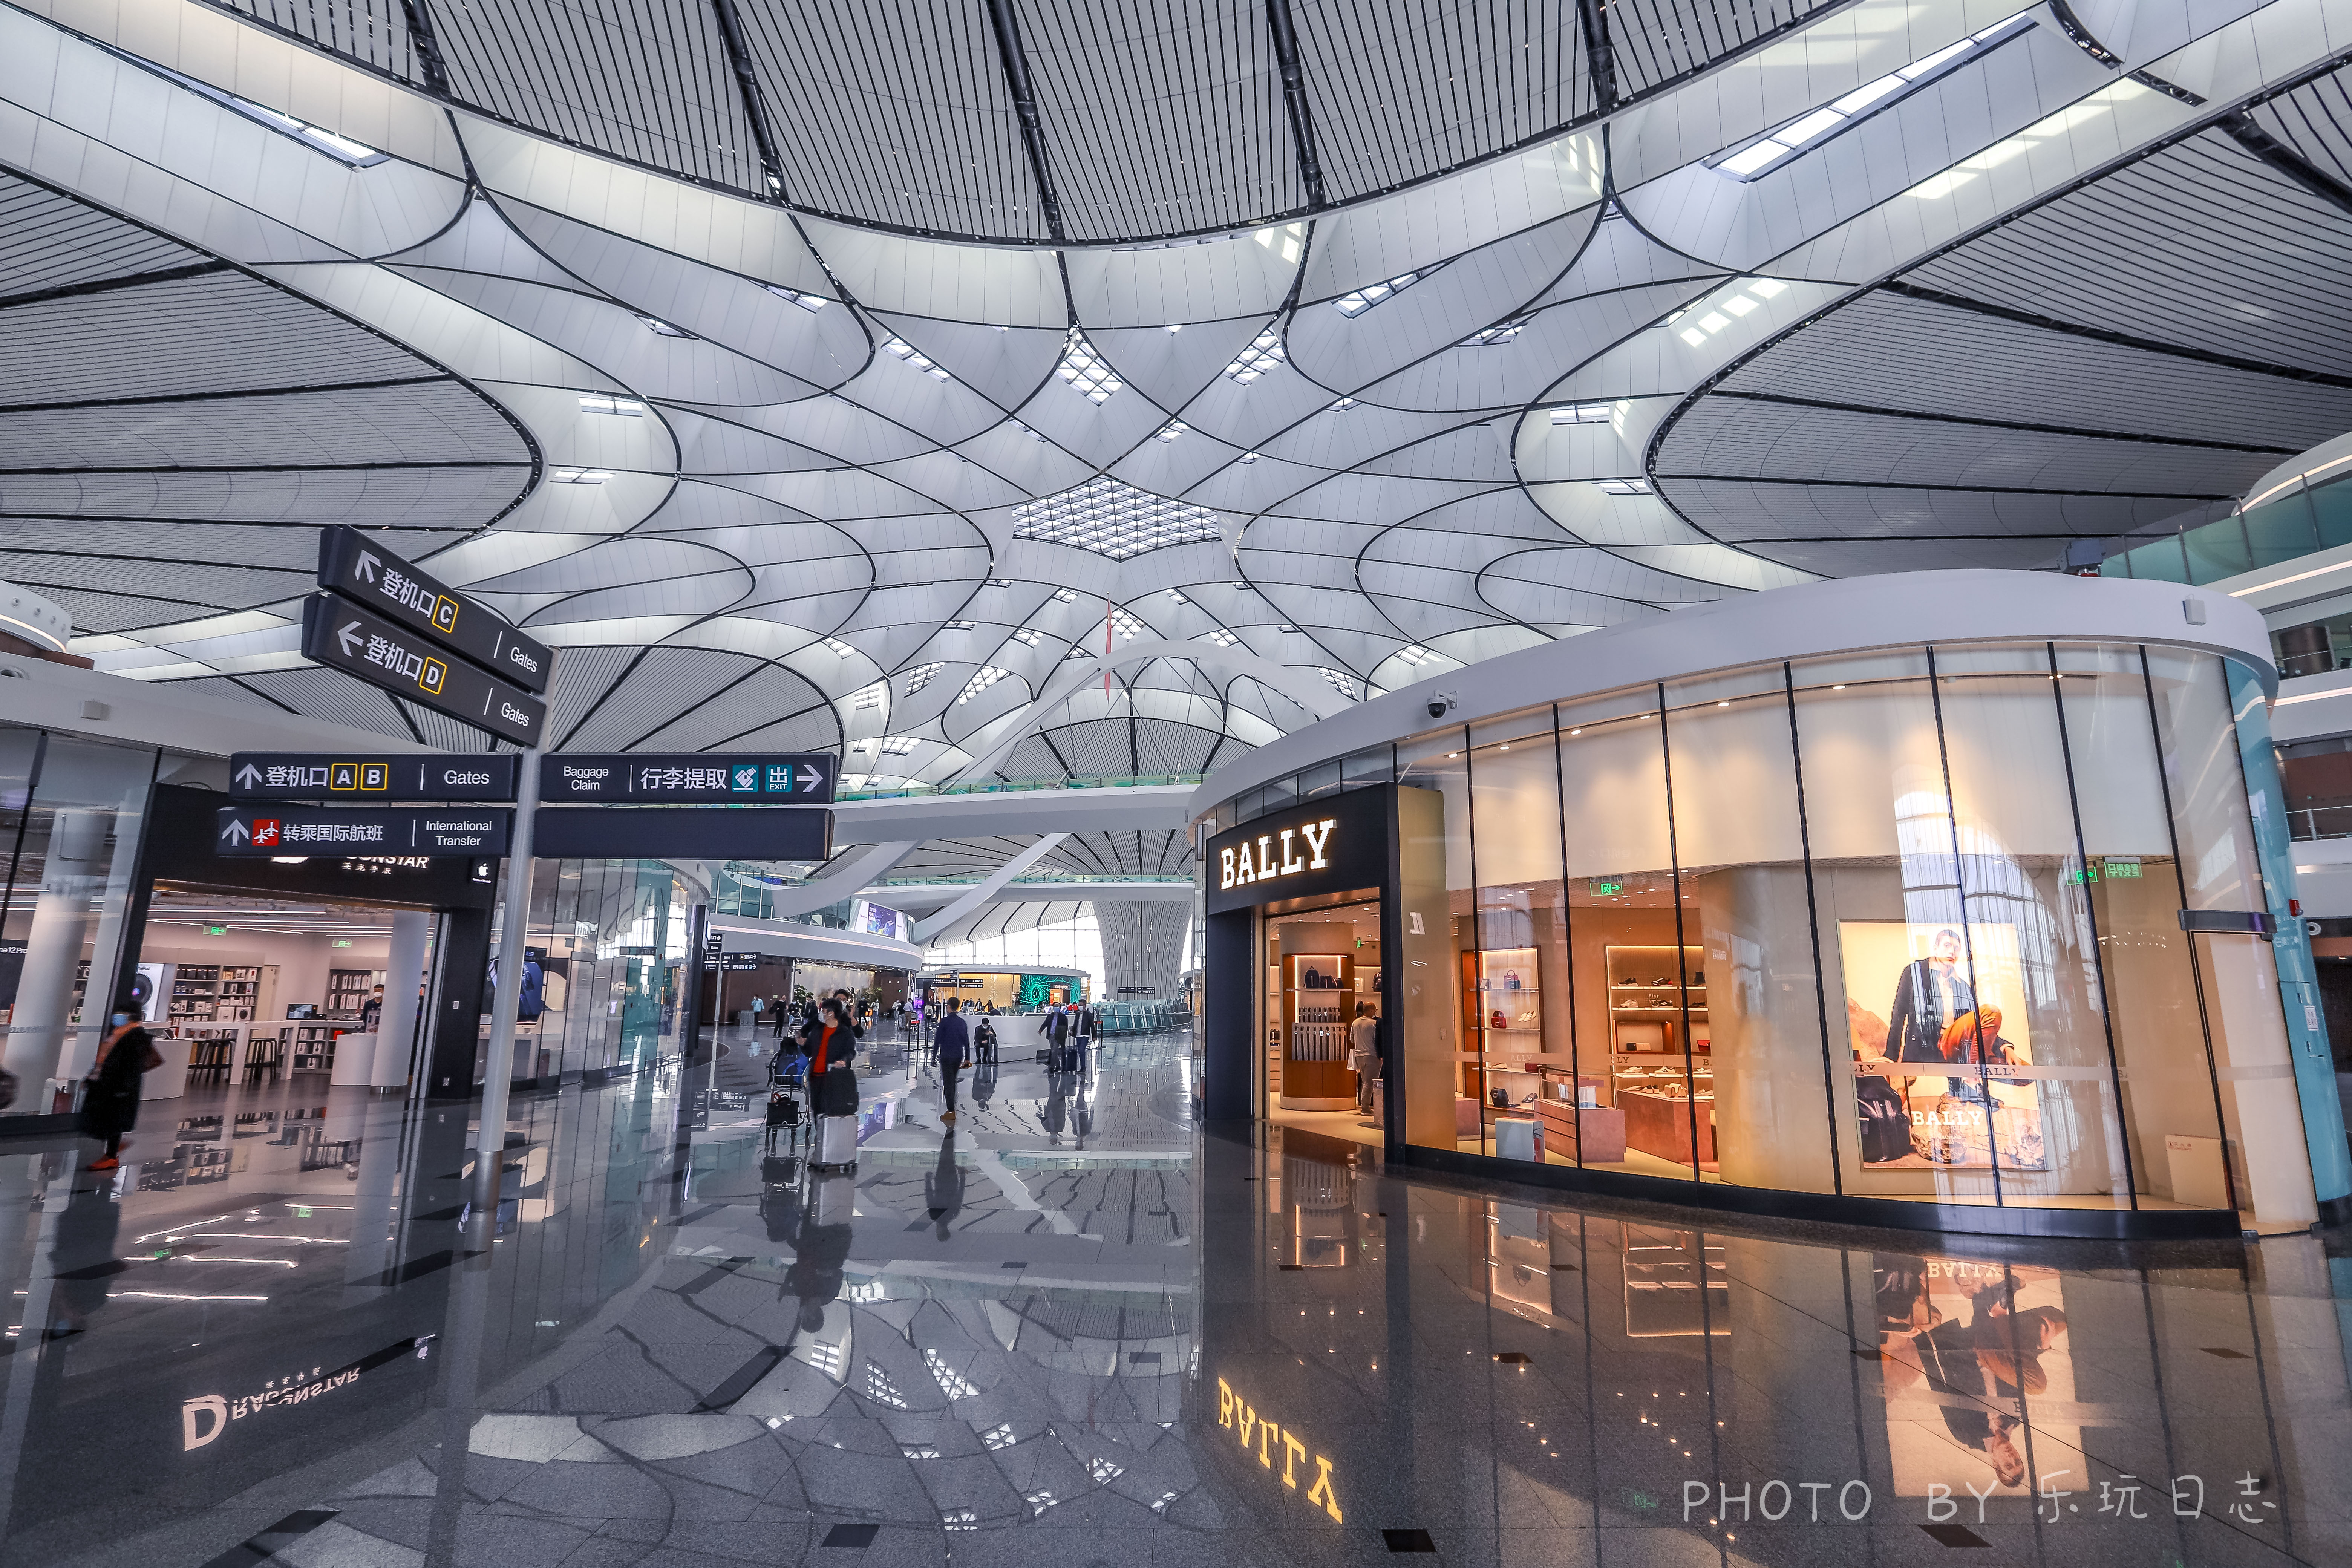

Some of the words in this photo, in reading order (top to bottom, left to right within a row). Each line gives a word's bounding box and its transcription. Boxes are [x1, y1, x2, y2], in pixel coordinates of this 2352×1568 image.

[378, 567, 436, 618] 登机口
[439, 605, 452, 624] C
[363, 634, 423, 681] 登机口
[426, 665, 439, 684] D
[510, 646, 538, 673] Gates
[501, 701, 530, 727] Gates
[265, 765, 329, 787] 登机口
[336, 769, 351, 784] A
[367, 769, 381, 784] B
[444, 769, 490, 785] Gates
[563, 766, 609, 778] Baggage
[640, 767, 727, 790] 行李提取
[769, 767, 788, 783] 出
[570, 779, 600, 790] Claim
[282, 824, 384, 841] 转乘国际航班
[426, 820, 492, 831] International
[435, 835, 482, 846] Transfer
[1220, 819, 1337, 890] BALLY
[1911, 1110, 1983, 1125] BALLY
